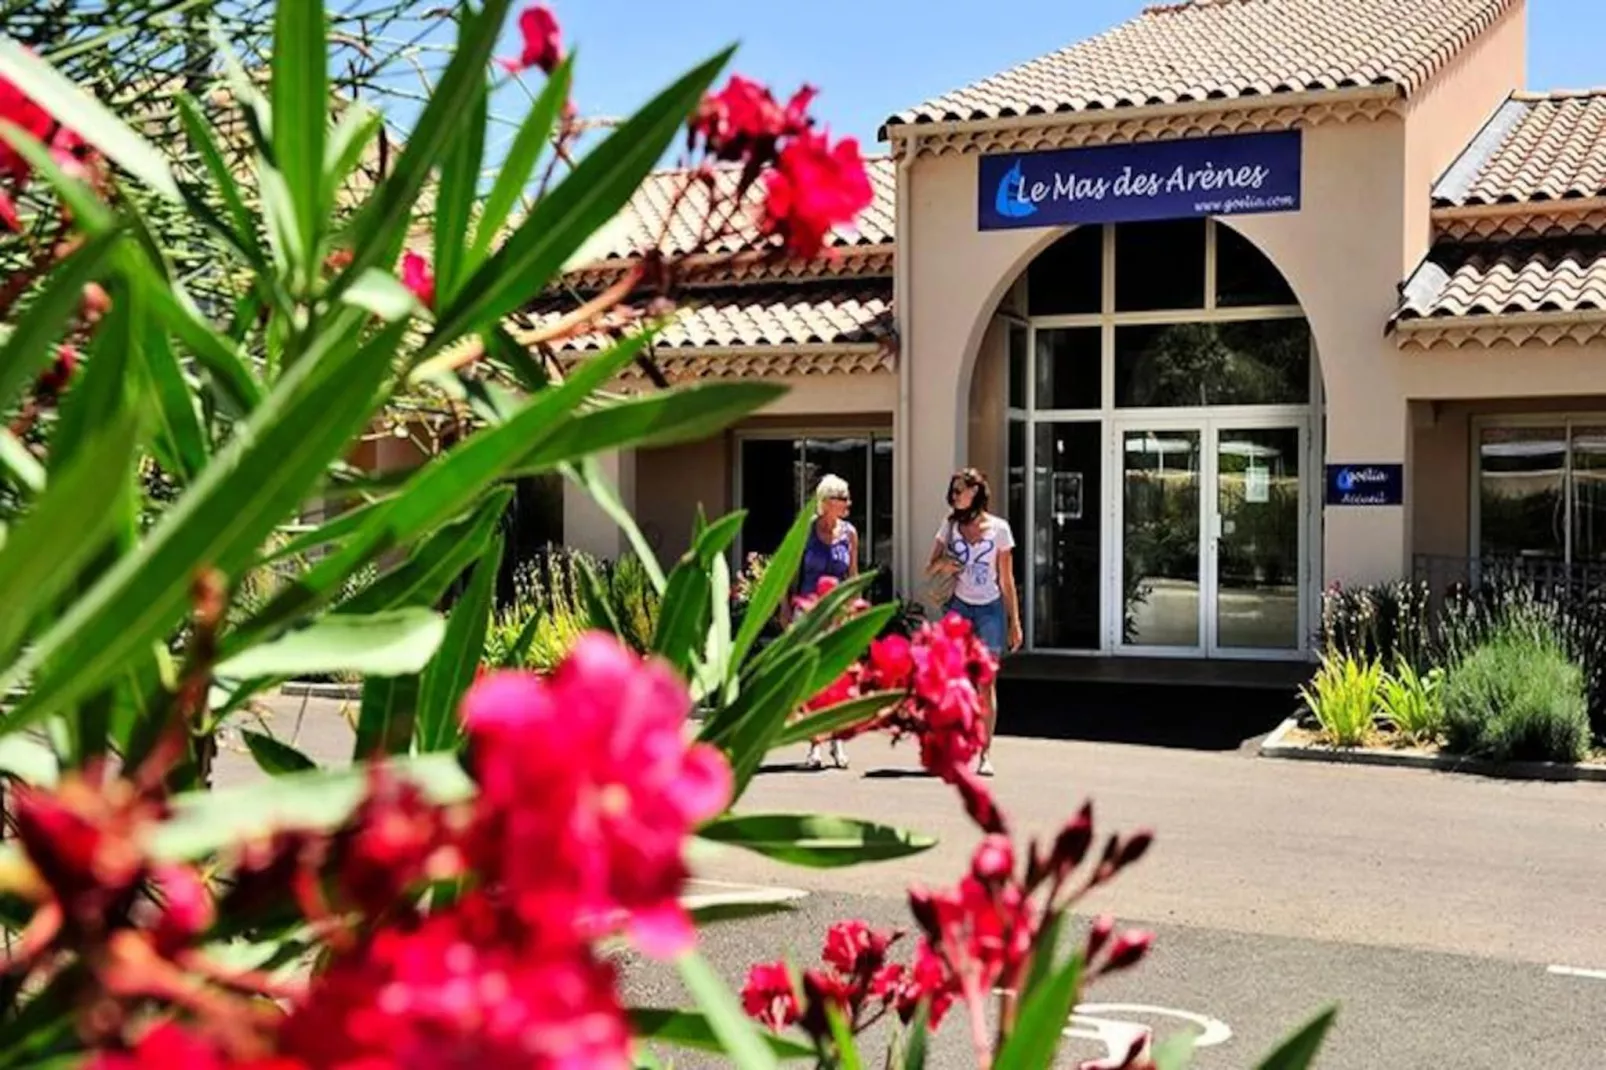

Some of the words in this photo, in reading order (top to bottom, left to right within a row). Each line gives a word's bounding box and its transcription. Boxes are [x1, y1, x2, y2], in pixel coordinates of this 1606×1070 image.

[1017, 175, 1050, 204] Le
[1053, 172, 1111, 201] Mas
[1113, 166, 1164, 197] des
[1166, 161, 1269, 193] Arènes
[1194, 195, 1294, 213] www.goelia.com
